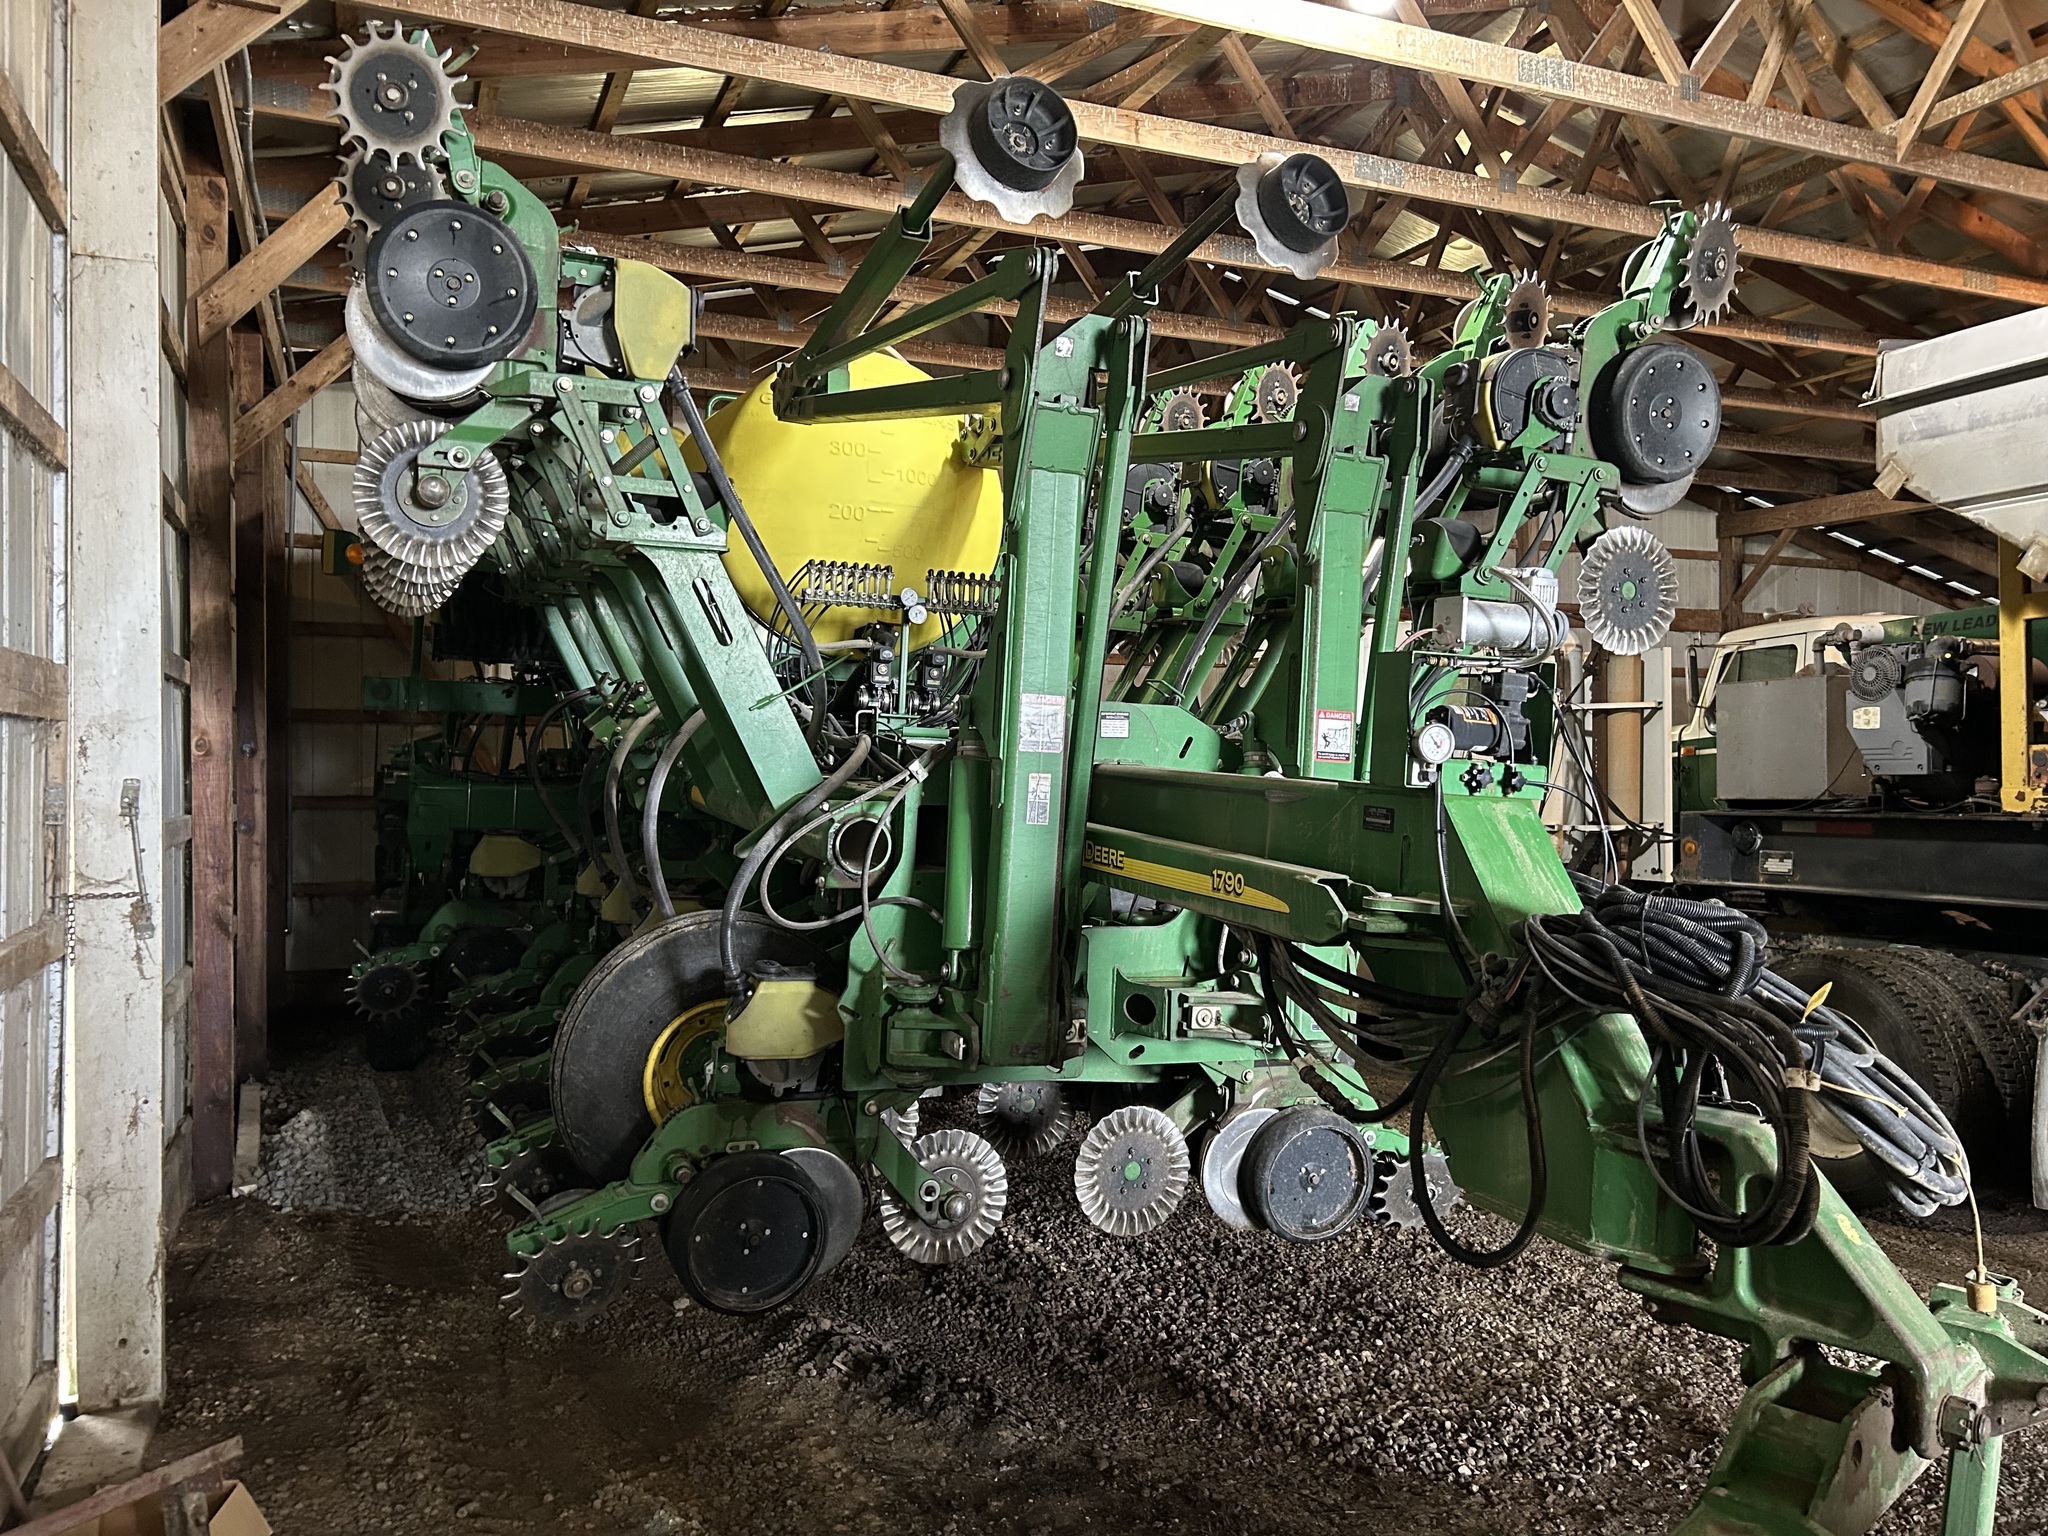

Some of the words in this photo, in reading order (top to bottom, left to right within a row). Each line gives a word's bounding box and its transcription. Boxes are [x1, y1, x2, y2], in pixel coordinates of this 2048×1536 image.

[830, 440, 866, 457] 300
[896, 469, 936, 486] 1000
[829, 503, 864, 521] 200
[1325, 712, 1351, 720] DANGER
[1085, 840, 1125, 869] DEERE
[1212, 868, 1245, 895] 1790
